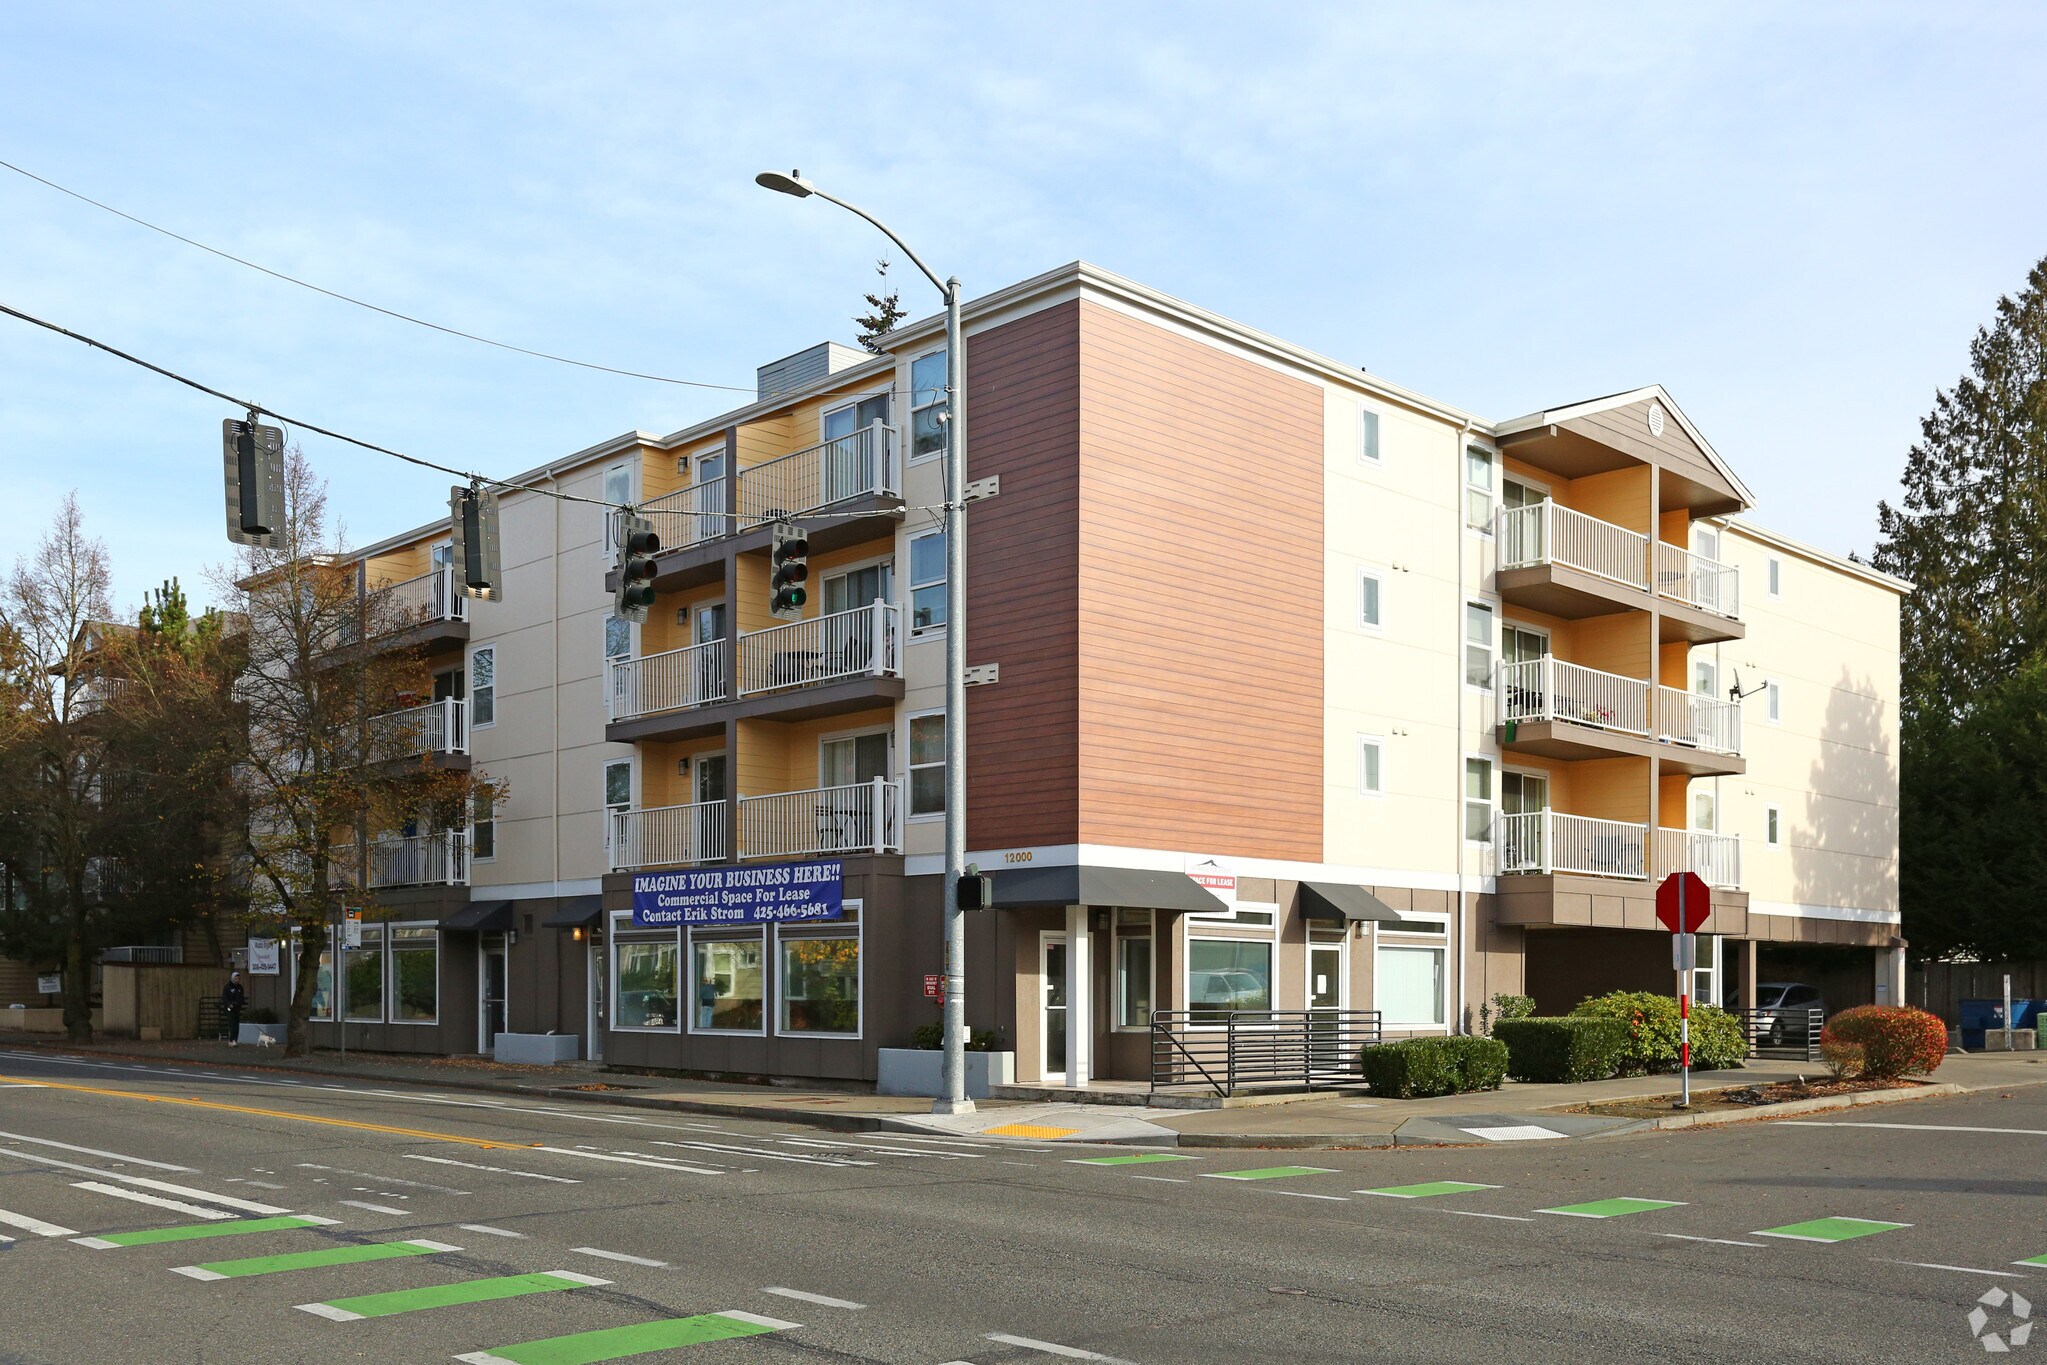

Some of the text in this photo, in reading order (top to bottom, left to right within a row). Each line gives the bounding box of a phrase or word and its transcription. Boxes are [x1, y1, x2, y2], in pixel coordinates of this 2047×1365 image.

[1004, 851, 1032, 863] 12000
[635, 863, 840, 892] IMAGINE YOUR BUSINESS HERE!!
[1206, 877, 1217, 885] FOR
[1217, 878, 1234, 887] LEASE
[657, 887, 811, 907] Commercial Space For Lease
[642, 902, 829, 922] Contact Erik Strom 425-466-5681
